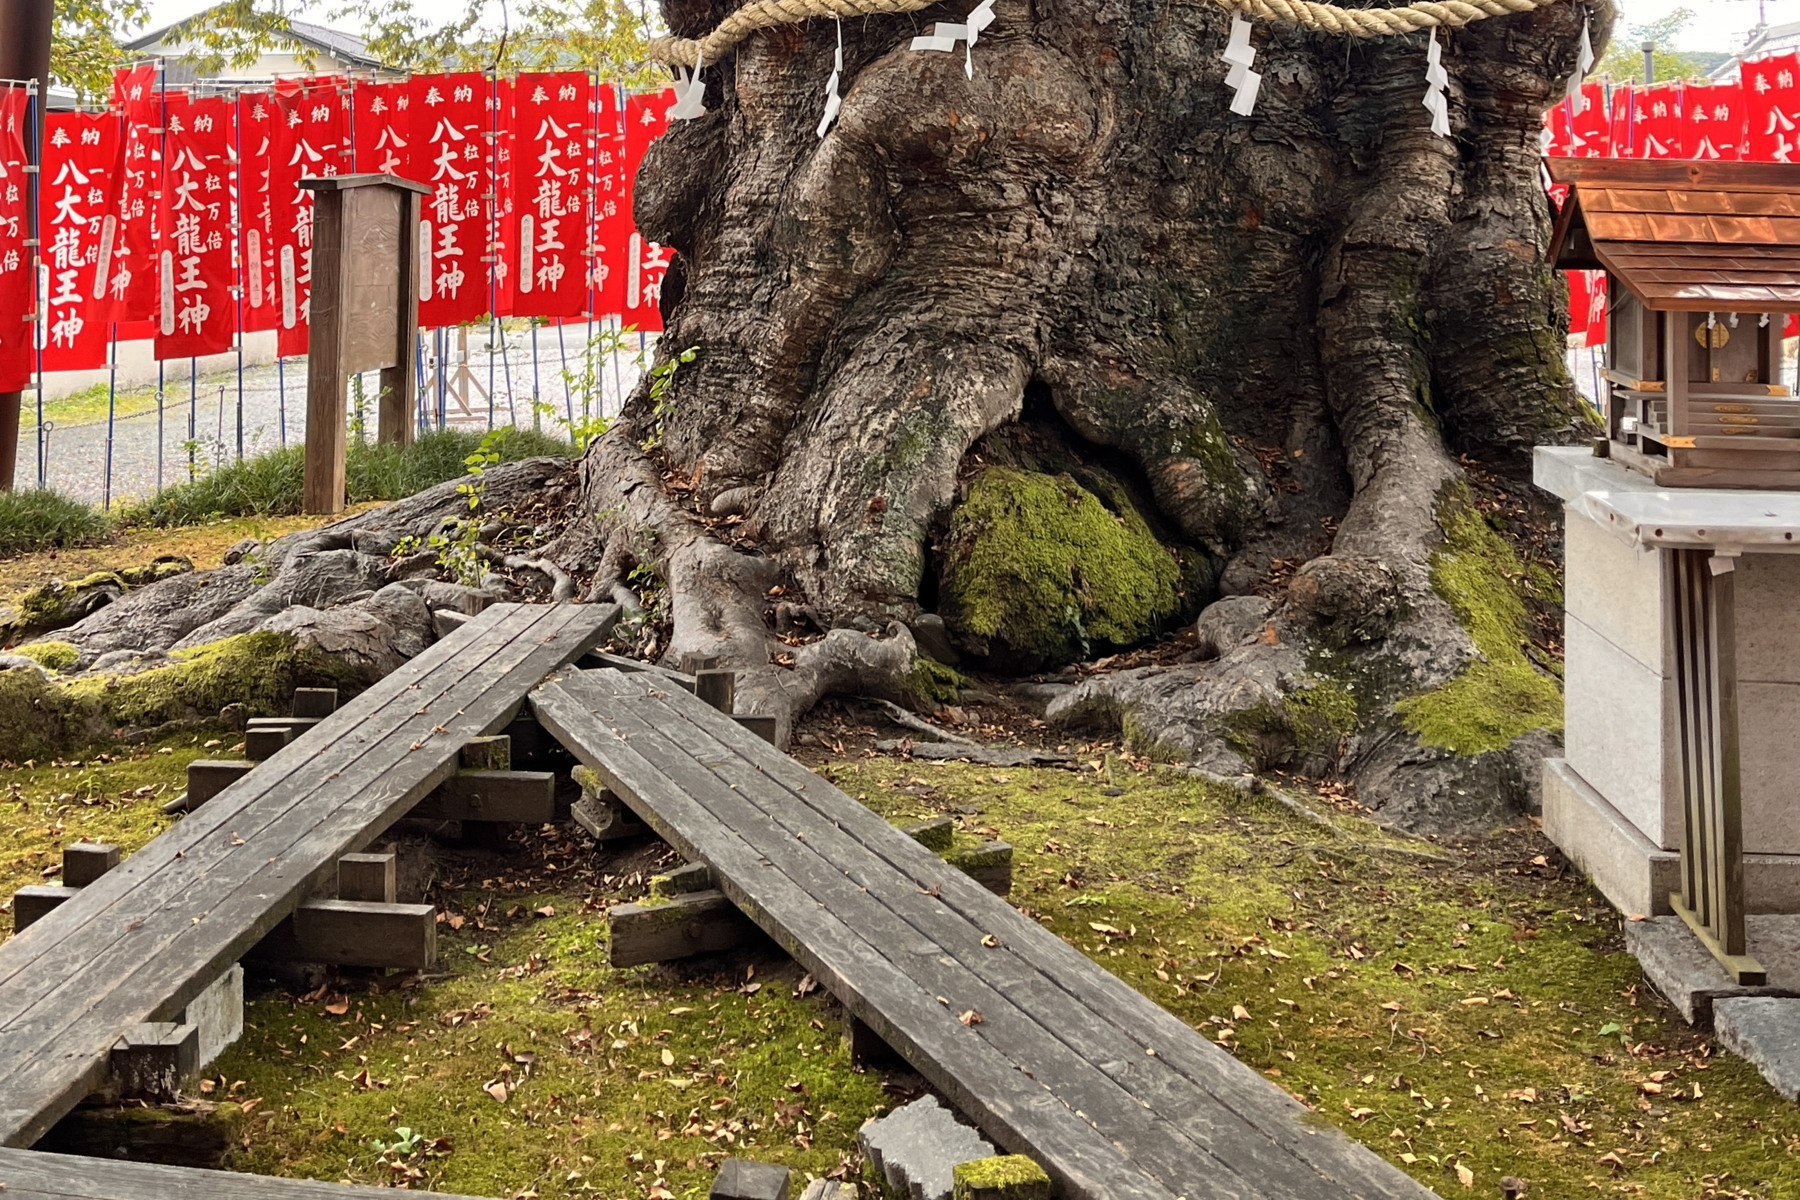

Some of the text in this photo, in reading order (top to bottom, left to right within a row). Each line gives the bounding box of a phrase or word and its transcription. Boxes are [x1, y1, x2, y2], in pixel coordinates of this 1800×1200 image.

[168, 114, 213, 135] 奉納
[287, 104, 330, 129] 奉納
[425, 84, 473, 107] 奉納
[530, 84, 577, 105] 奉納
[1634, 100, 1667, 124] 奉納
[1691, 104, 1729, 124] 奉納
[1755, 68, 1794, 94] 奉納
[50, 126, 101, 149] 奉納
[131, 123, 149, 218] 一粒万倍
[464, 124, 480, 218] 一粒万倍
[566, 123, 581, 213] 一粒万倍
[597, 132, 617, 218] 一粒万倍
[3, 160, 20, 272] 一粒万倍
[85, 168, 104, 264] 一粒万倍
[170, 145, 210, 335] 八大龍王神
[205, 154, 222, 250] 一粒万倍
[429, 116, 466, 300] 八大龍王神
[532, 115, 568, 293] 八大龍王神
[48, 158, 90, 349] 八大龍王神
